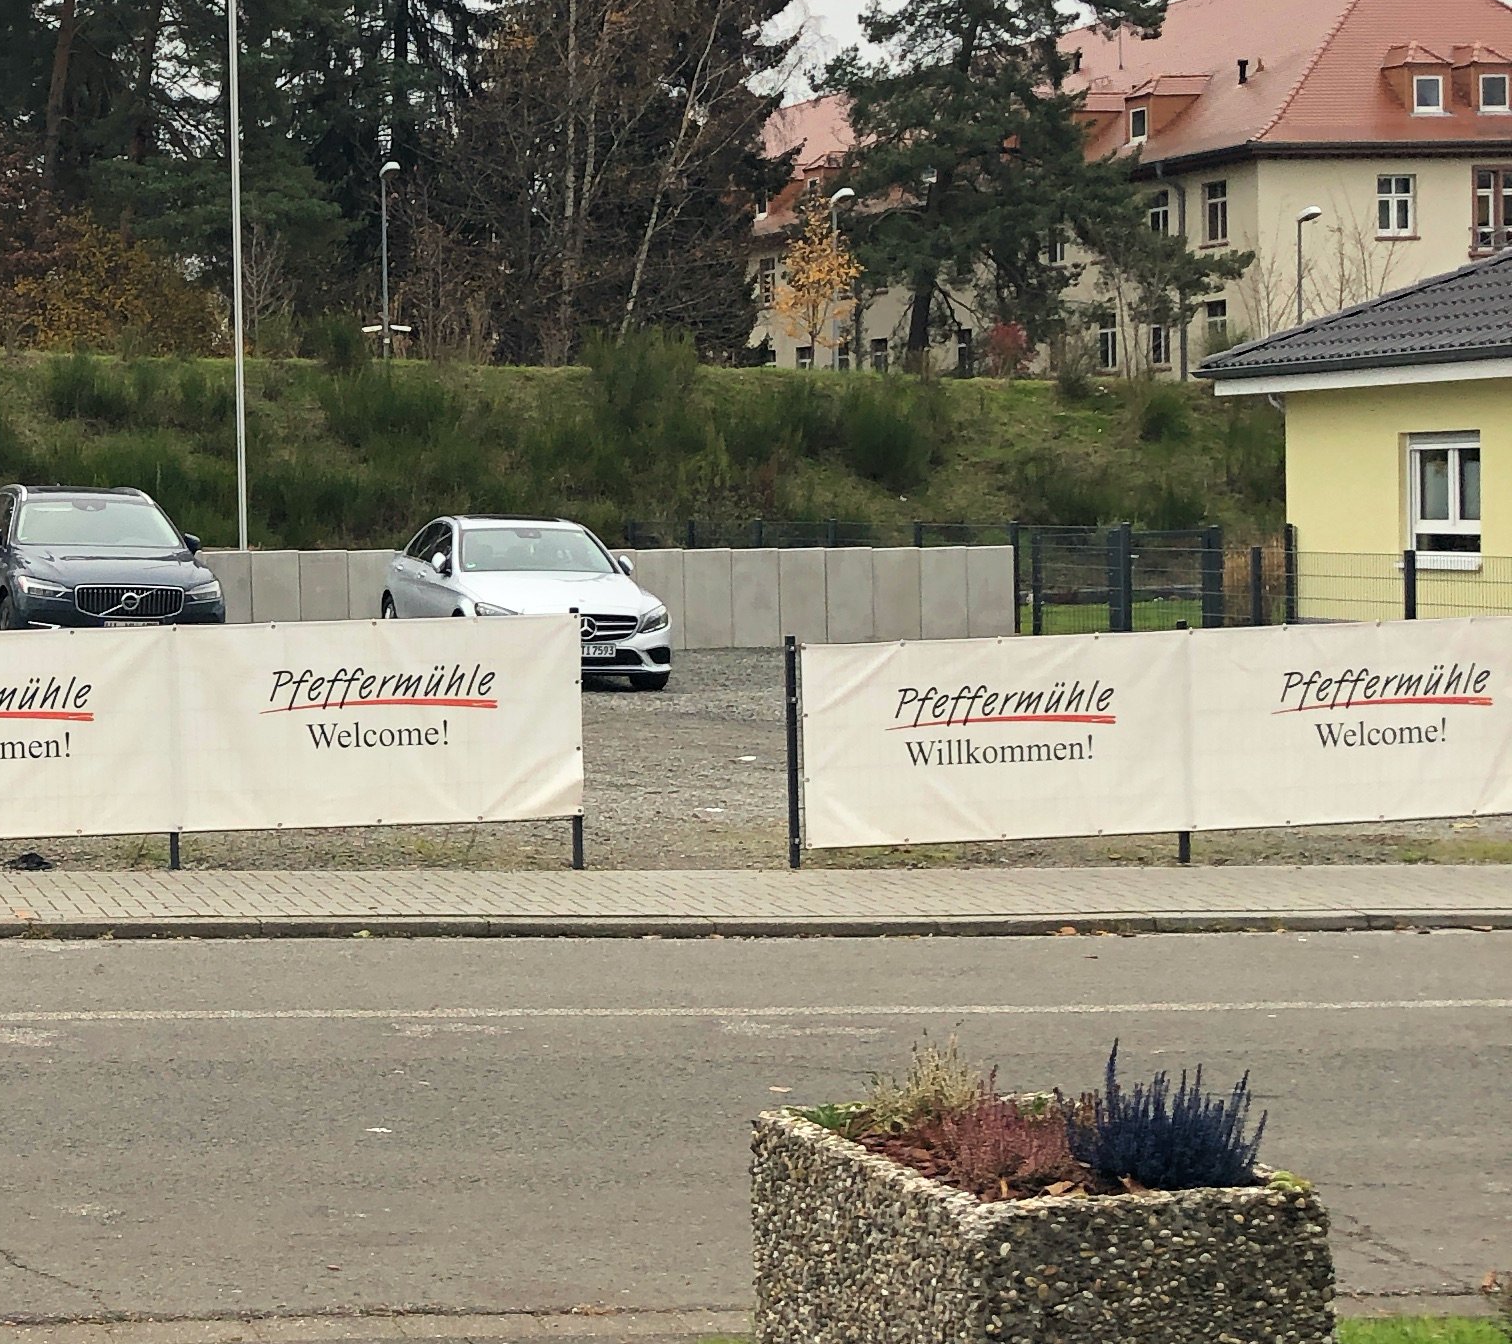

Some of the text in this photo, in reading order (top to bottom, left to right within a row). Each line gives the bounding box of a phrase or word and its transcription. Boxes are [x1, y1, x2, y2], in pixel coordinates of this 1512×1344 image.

[592, 646, 614, 655] 7593
[270, 664, 496, 710] Pfeffermühle
[1281, 663, 1491, 711] Pfeffermühle
[895, 681, 1115, 727] Pfeffermühle
[307, 720, 449, 749] Welcome!
[1316, 718, 1447, 747] Welcome!
[905, 735, 1093, 766] Willkommen!
